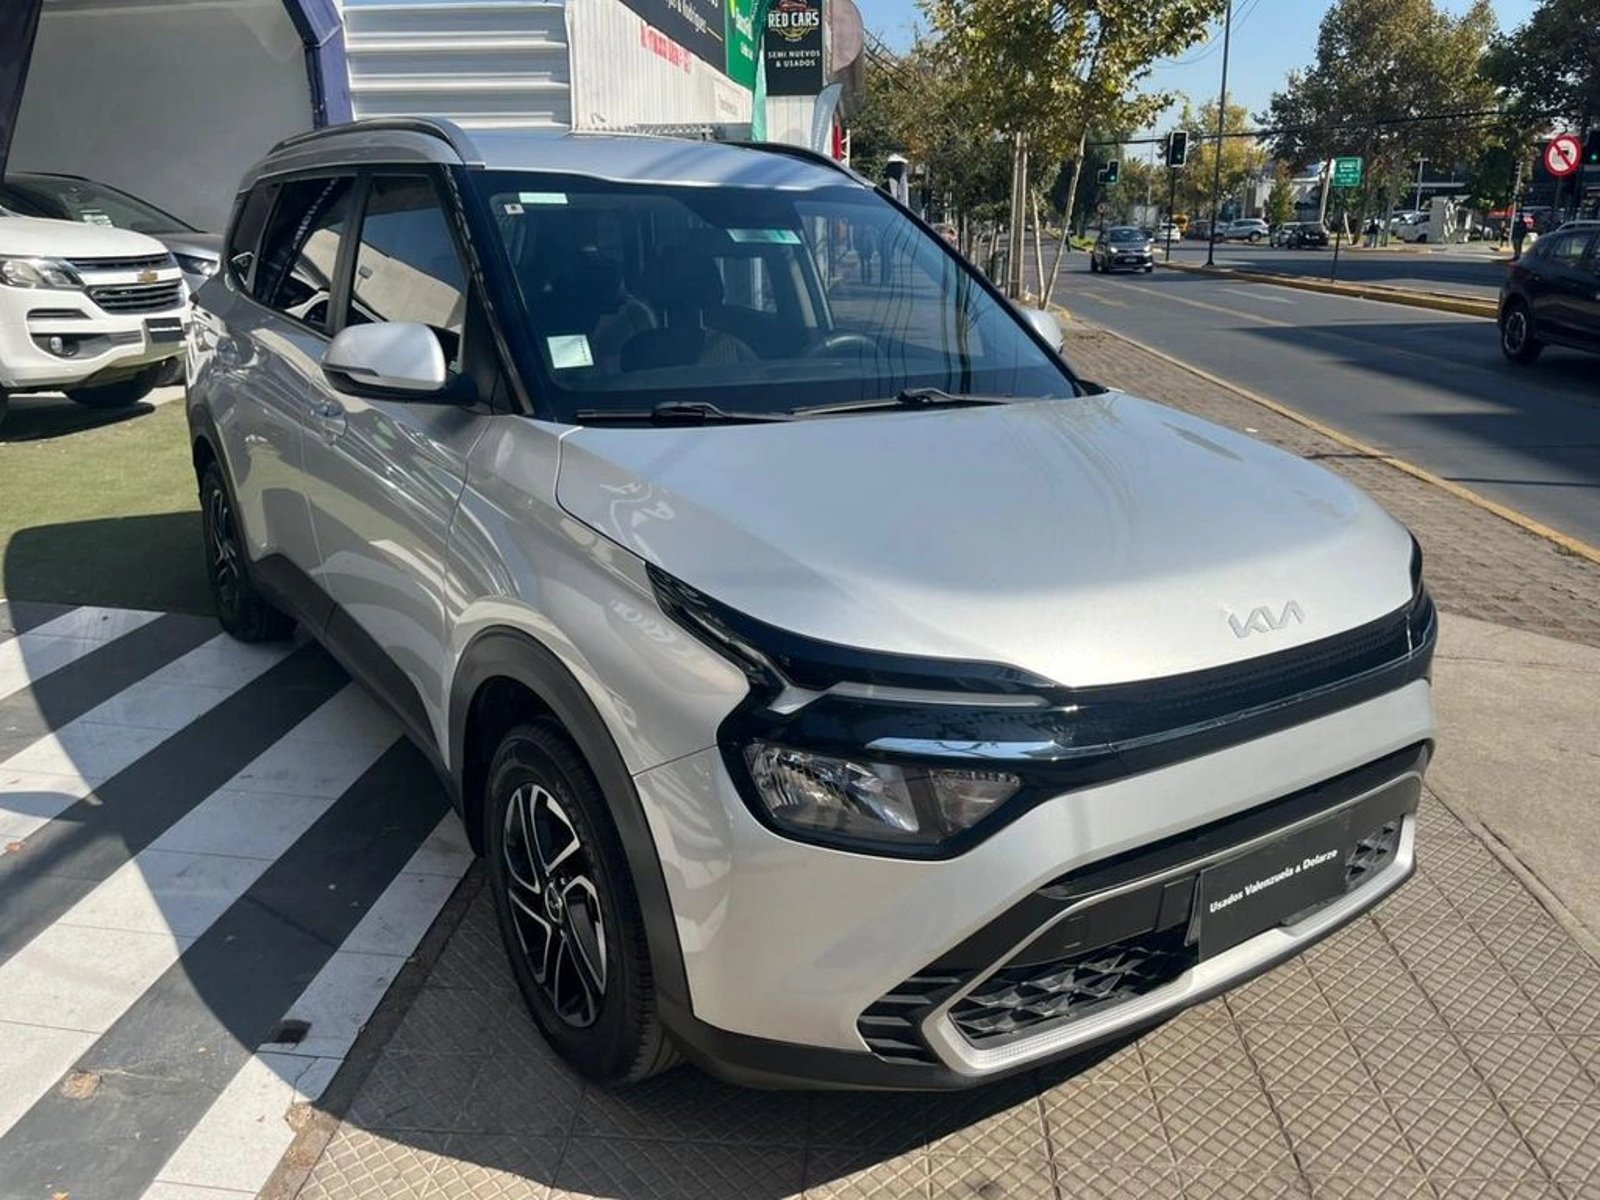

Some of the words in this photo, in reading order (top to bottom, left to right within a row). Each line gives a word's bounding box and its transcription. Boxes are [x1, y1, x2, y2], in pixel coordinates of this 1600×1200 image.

[768, 13, 788, 28] RED
[791, 11, 820, 26] CARS
[768, 51, 787, 59] SEMI
[789, 50, 821, 58] NUEVOS
[783, 59, 816, 67] USADOS
[1228, 600, 1305, 638] KIA
[1210, 892, 1243, 912] Usados
[1245, 867, 1293, 895] Valenzuela
